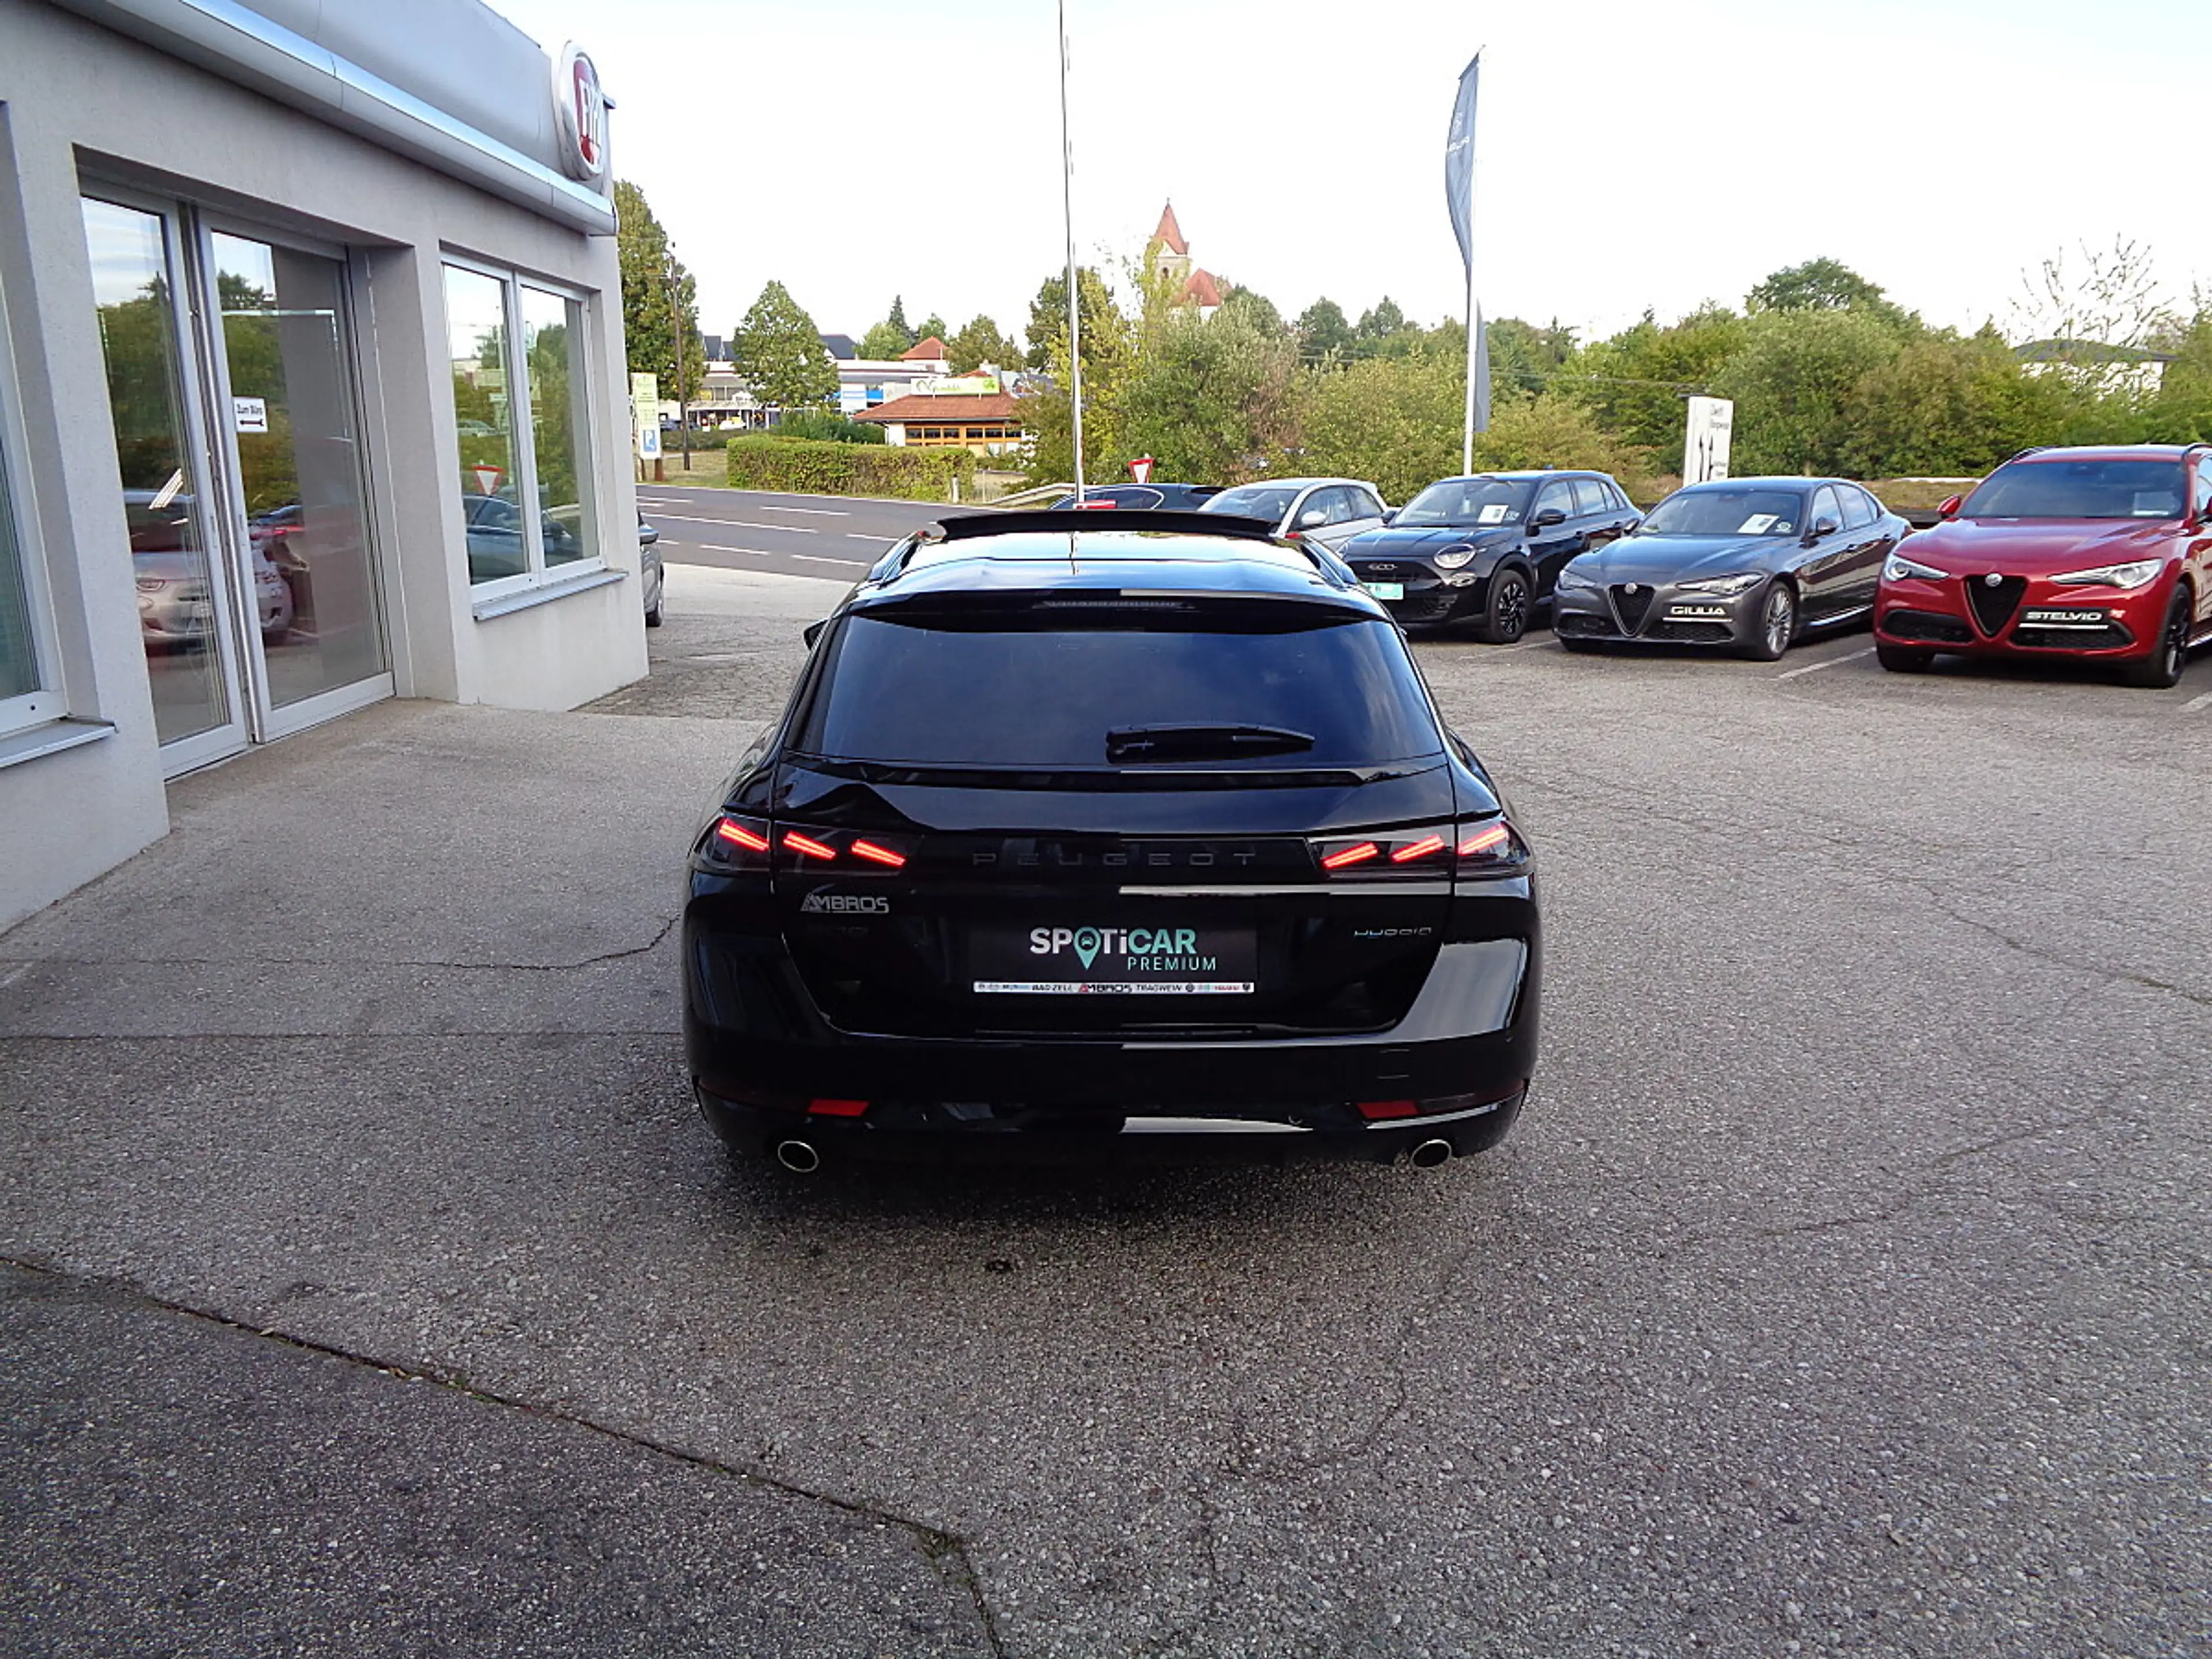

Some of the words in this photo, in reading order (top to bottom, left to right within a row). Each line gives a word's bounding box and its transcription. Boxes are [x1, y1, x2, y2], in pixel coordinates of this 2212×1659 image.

[1671, 606, 1726, 615] GIULIA
[2027, 611, 2103, 620] STELVIO
[972, 853, 1256, 866] PEUGEOT
[800, 892, 889, 913] AMBROS
[1127, 957, 1216, 971] PREMIUM
